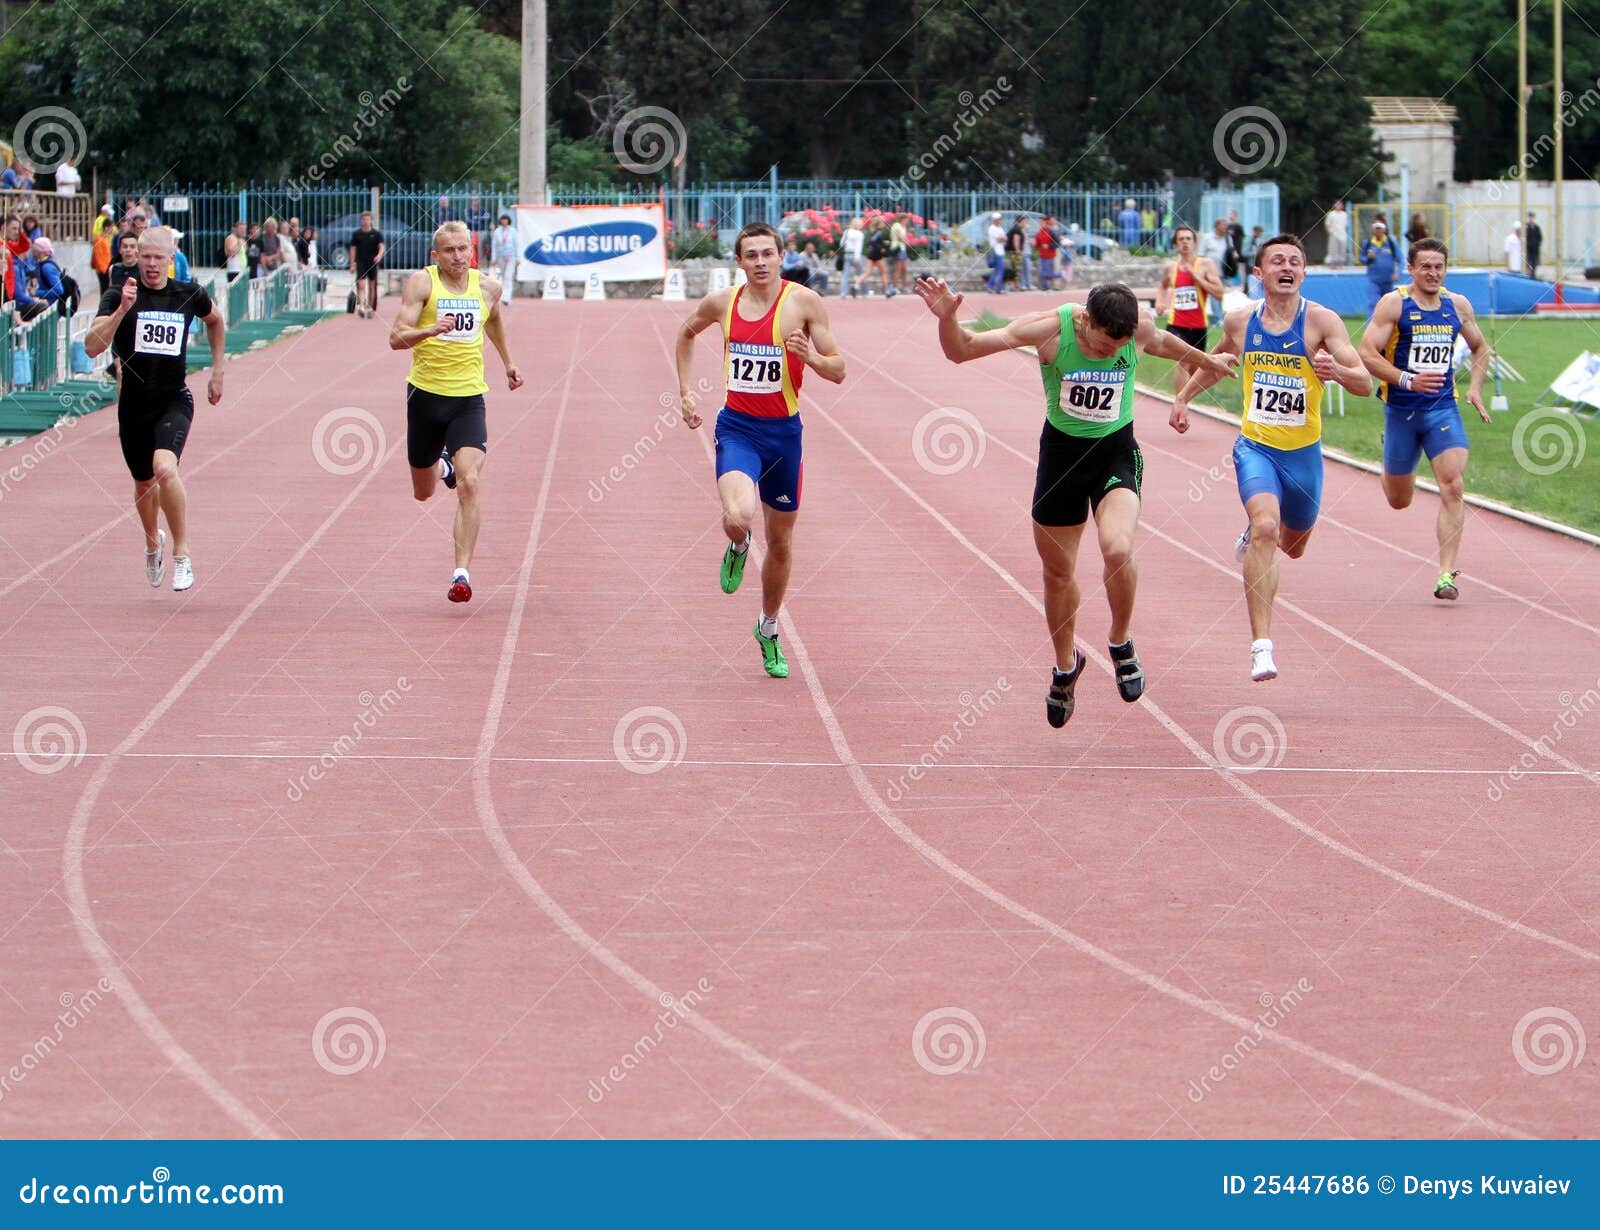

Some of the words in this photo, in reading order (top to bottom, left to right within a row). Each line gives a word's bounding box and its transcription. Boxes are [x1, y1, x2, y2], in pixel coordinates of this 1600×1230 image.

[541, 234, 642, 253] SAMSUNG
[549, 275, 559, 289] 6
[590, 272, 600, 287] 5
[669, 273, 679, 287] 4
[137, 311, 185, 322] SAMSUNG
[445, 313, 474, 331] 03
[143, 323, 177, 345] 398
[728, 342, 783, 355] SAMSUNG
[1413, 346, 1450, 364] 1202
[731, 358, 781, 382] 1278
[1248, 353, 1302, 370] UKRAINE
[1069, 385, 1115, 410] 602
[1254, 388, 1305, 414] 1294
